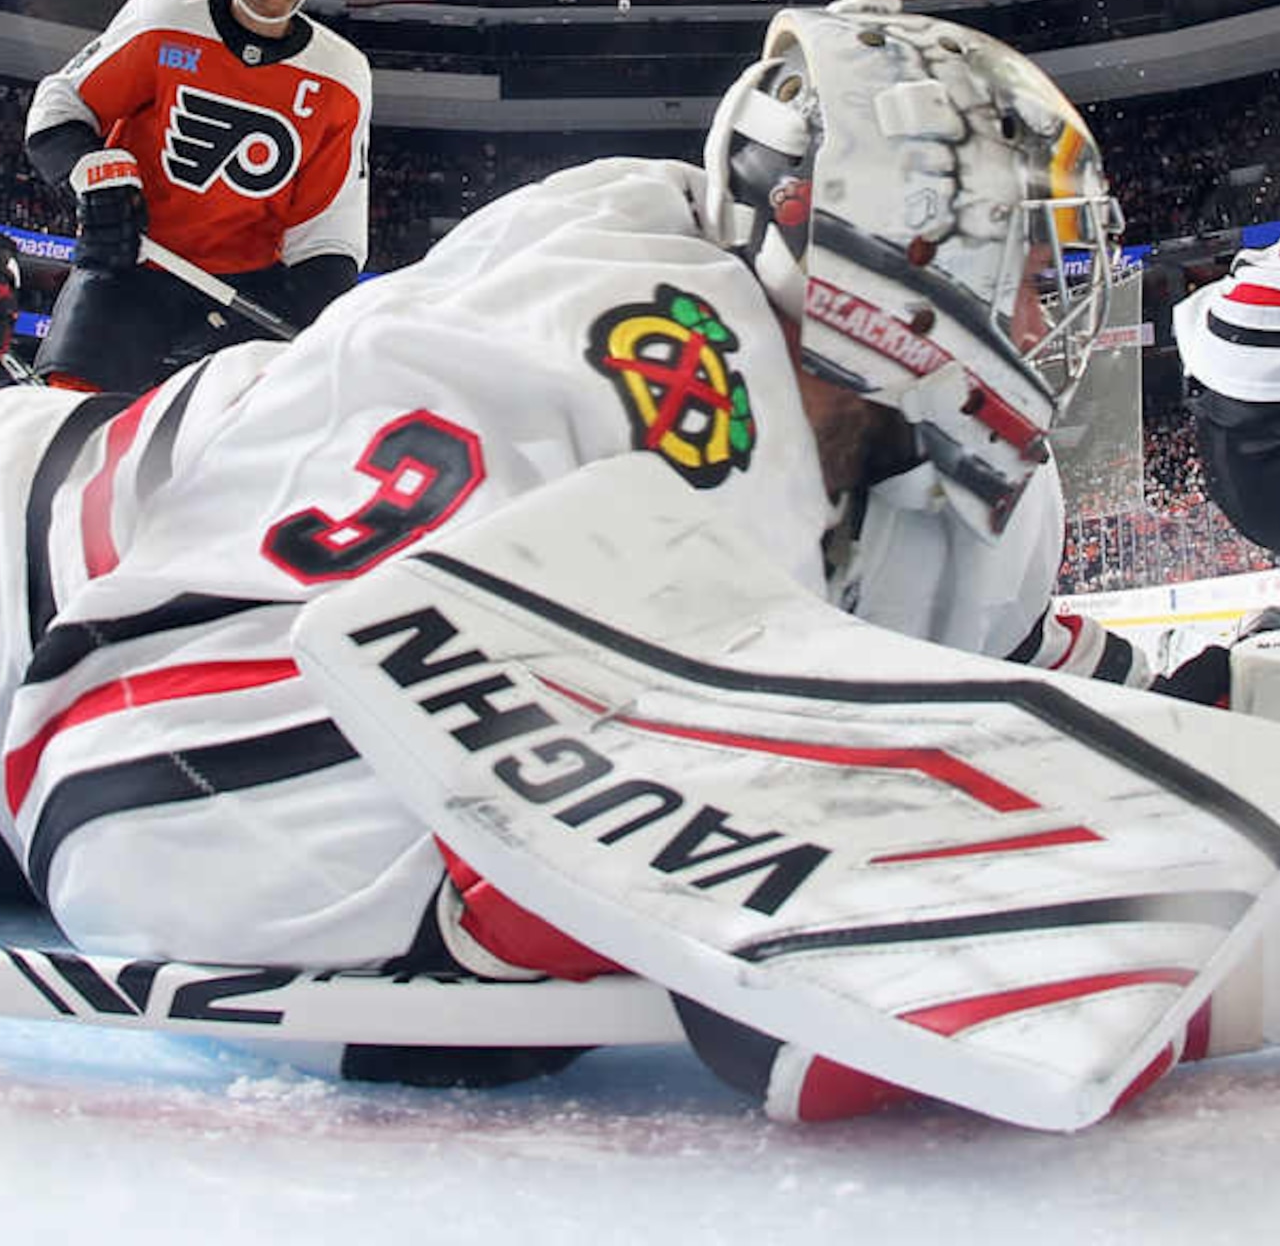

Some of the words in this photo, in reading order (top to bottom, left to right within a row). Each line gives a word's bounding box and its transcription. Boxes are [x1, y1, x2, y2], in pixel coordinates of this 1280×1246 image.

[292, 78, 322, 118] C
[261, 406, 487, 586] 3
[346, 604, 833, 918] VAUGHN
